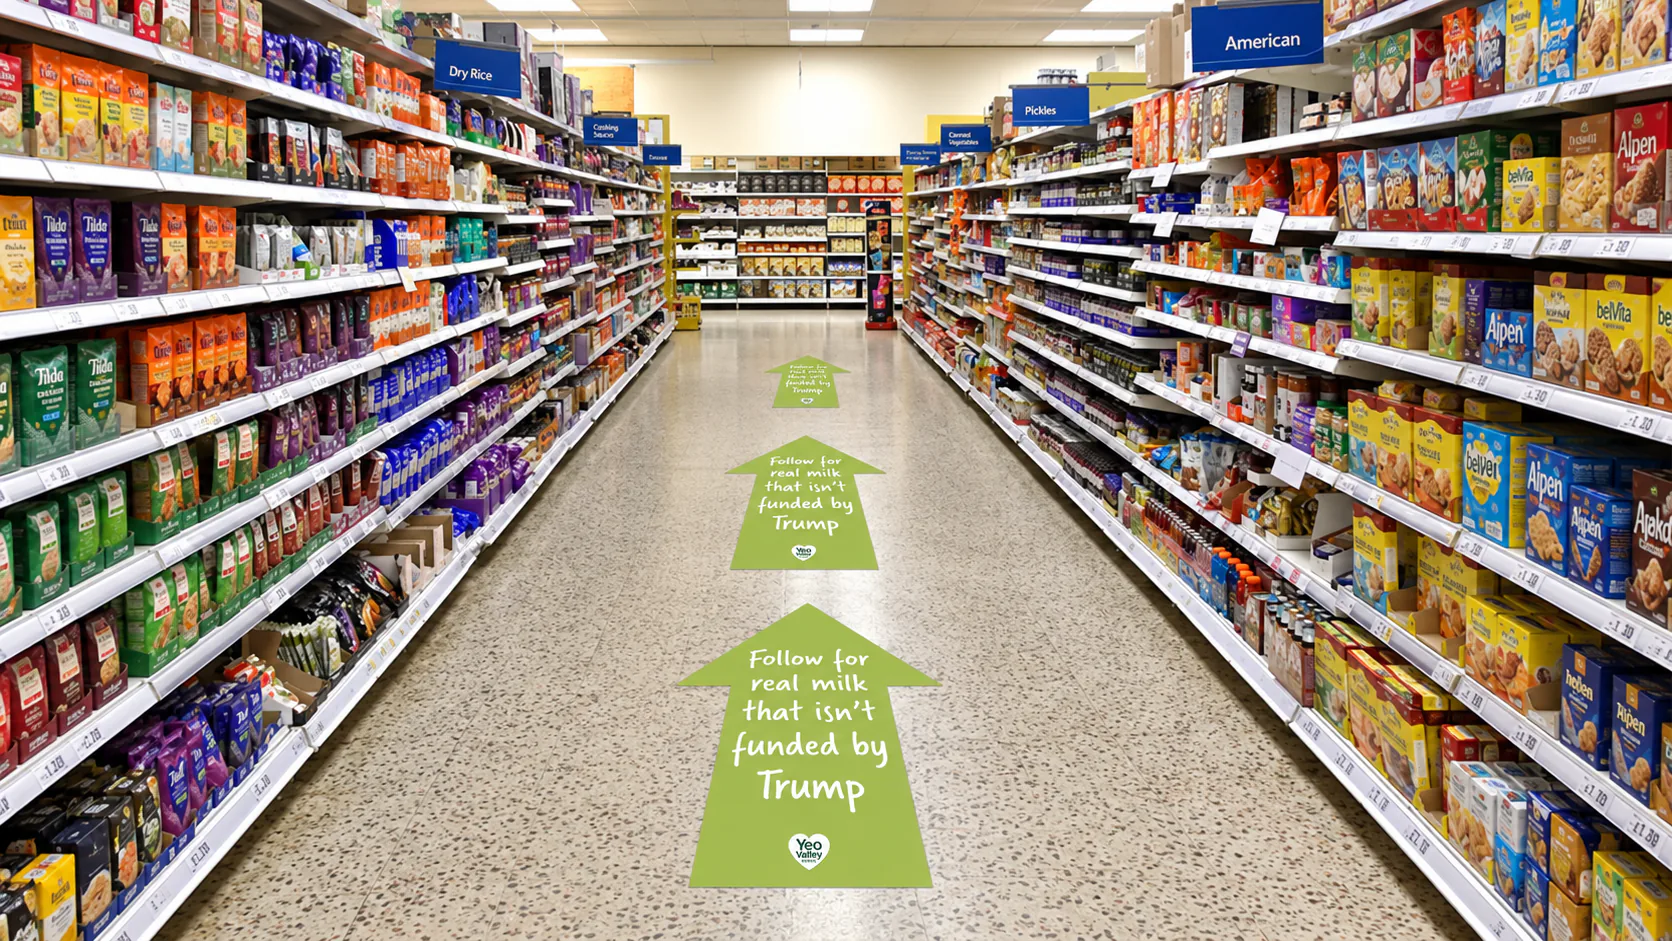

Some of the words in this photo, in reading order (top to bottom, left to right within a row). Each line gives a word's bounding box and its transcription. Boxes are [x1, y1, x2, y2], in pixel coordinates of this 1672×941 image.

[1225, 33, 1301, 51] American
[449, 65, 469, 81] Dry
[470, 68, 493, 81] Rice
[1025, 105, 1057, 116] Pickles
[1617, 130, 1657, 164] Alpen
[1596, 300, 1632, 323] belVita
[34, 366, 64, 386] Tilda
[87, 359, 113, 376] Tilda
[769, 456, 814, 466] Follow
[820, 456, 842, 468] for
[770, 468, 800, 478] real
[807, 468, 841, 478] milk
[764, 480, 802, 492] that
[809, 480, 846, 493] isn't
[757, 496, 824, 515] funded
[830, 496, 854, 515] by
[772, 514, 839, 537] Trump
[749, 648, 824, 669] Follow
[833, 648, 870, 673] for
[751, 674, 799, 692] real
[811, 674, 869, 692] milk
[742, 700, 804, 721] that
[815, 700, 876, 723] isn't
[731, 731, 840, 768] funded
[851, 730, 889, 769] by
[756, 768, 865, 814] Trump
[796, 838, 822, 851] Yeo
[796, 850, 822, 861] Valley
